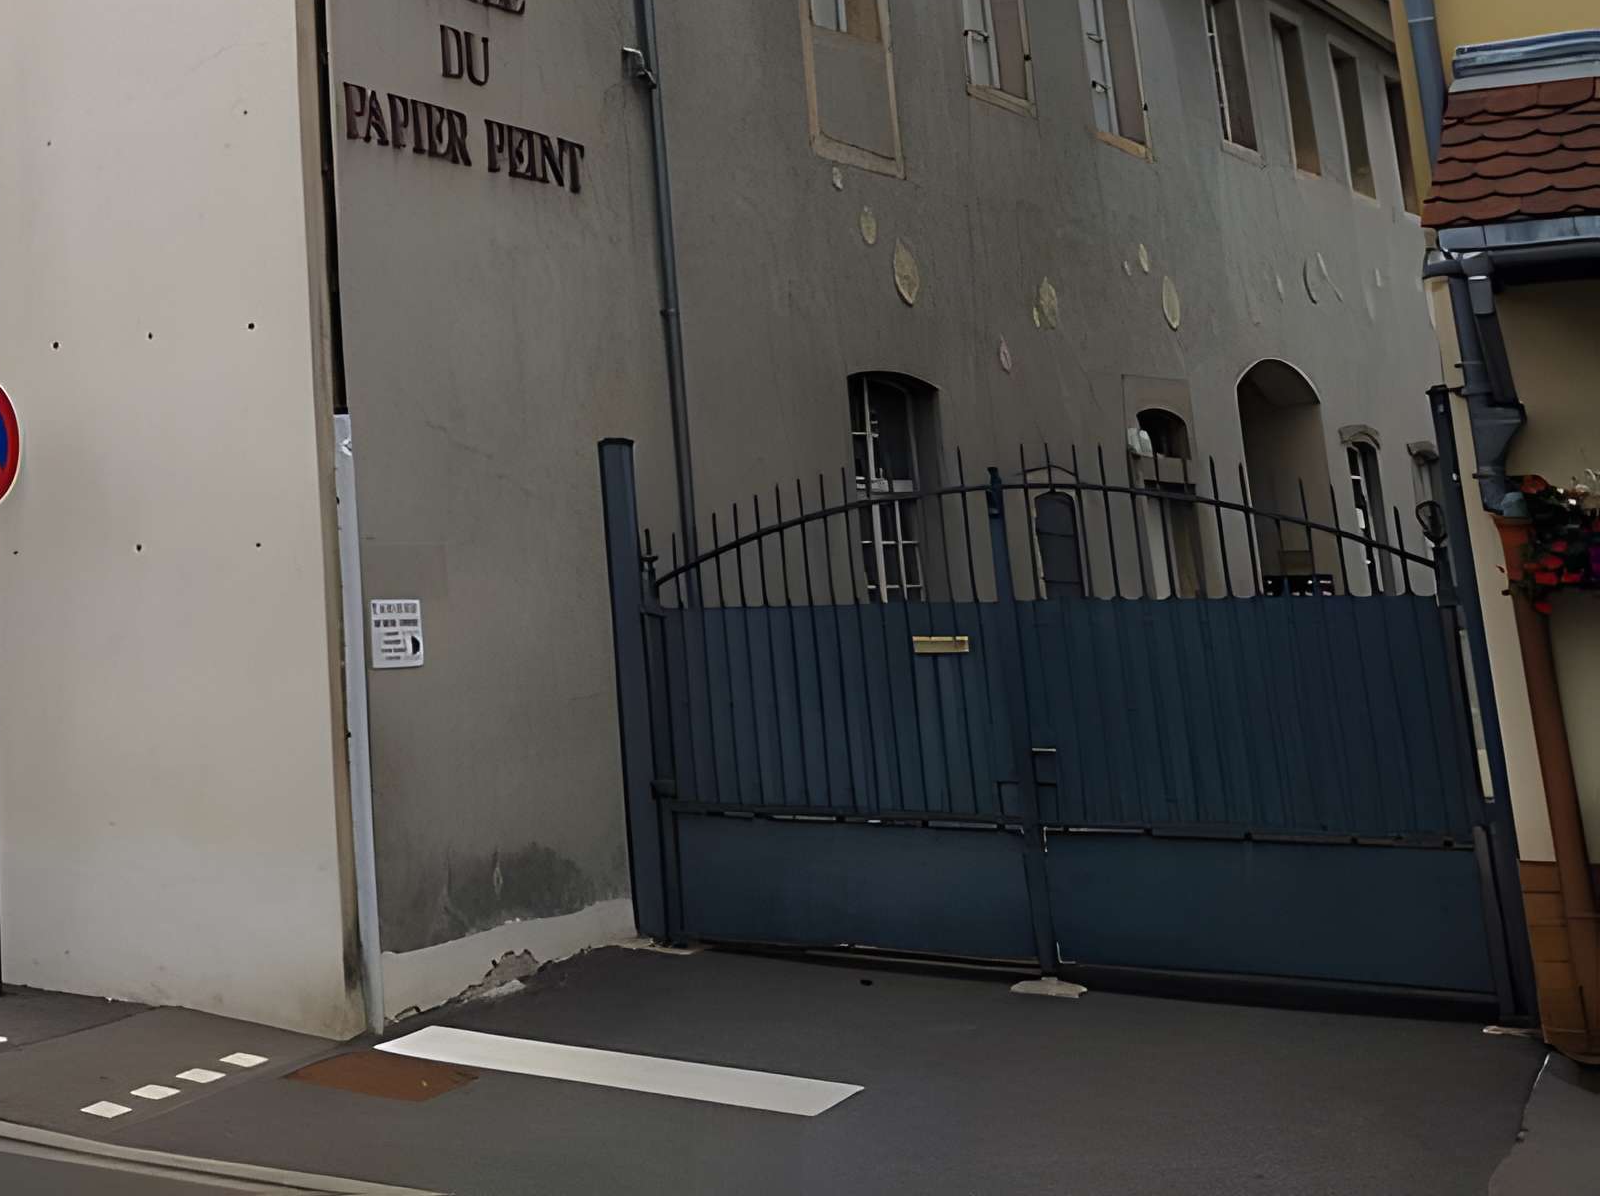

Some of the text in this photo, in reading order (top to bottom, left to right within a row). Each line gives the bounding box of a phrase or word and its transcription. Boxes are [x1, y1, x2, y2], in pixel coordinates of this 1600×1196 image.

[440, 25, 489, 86] DU
[343, 82, 585, 194] PAPIER PEINT
